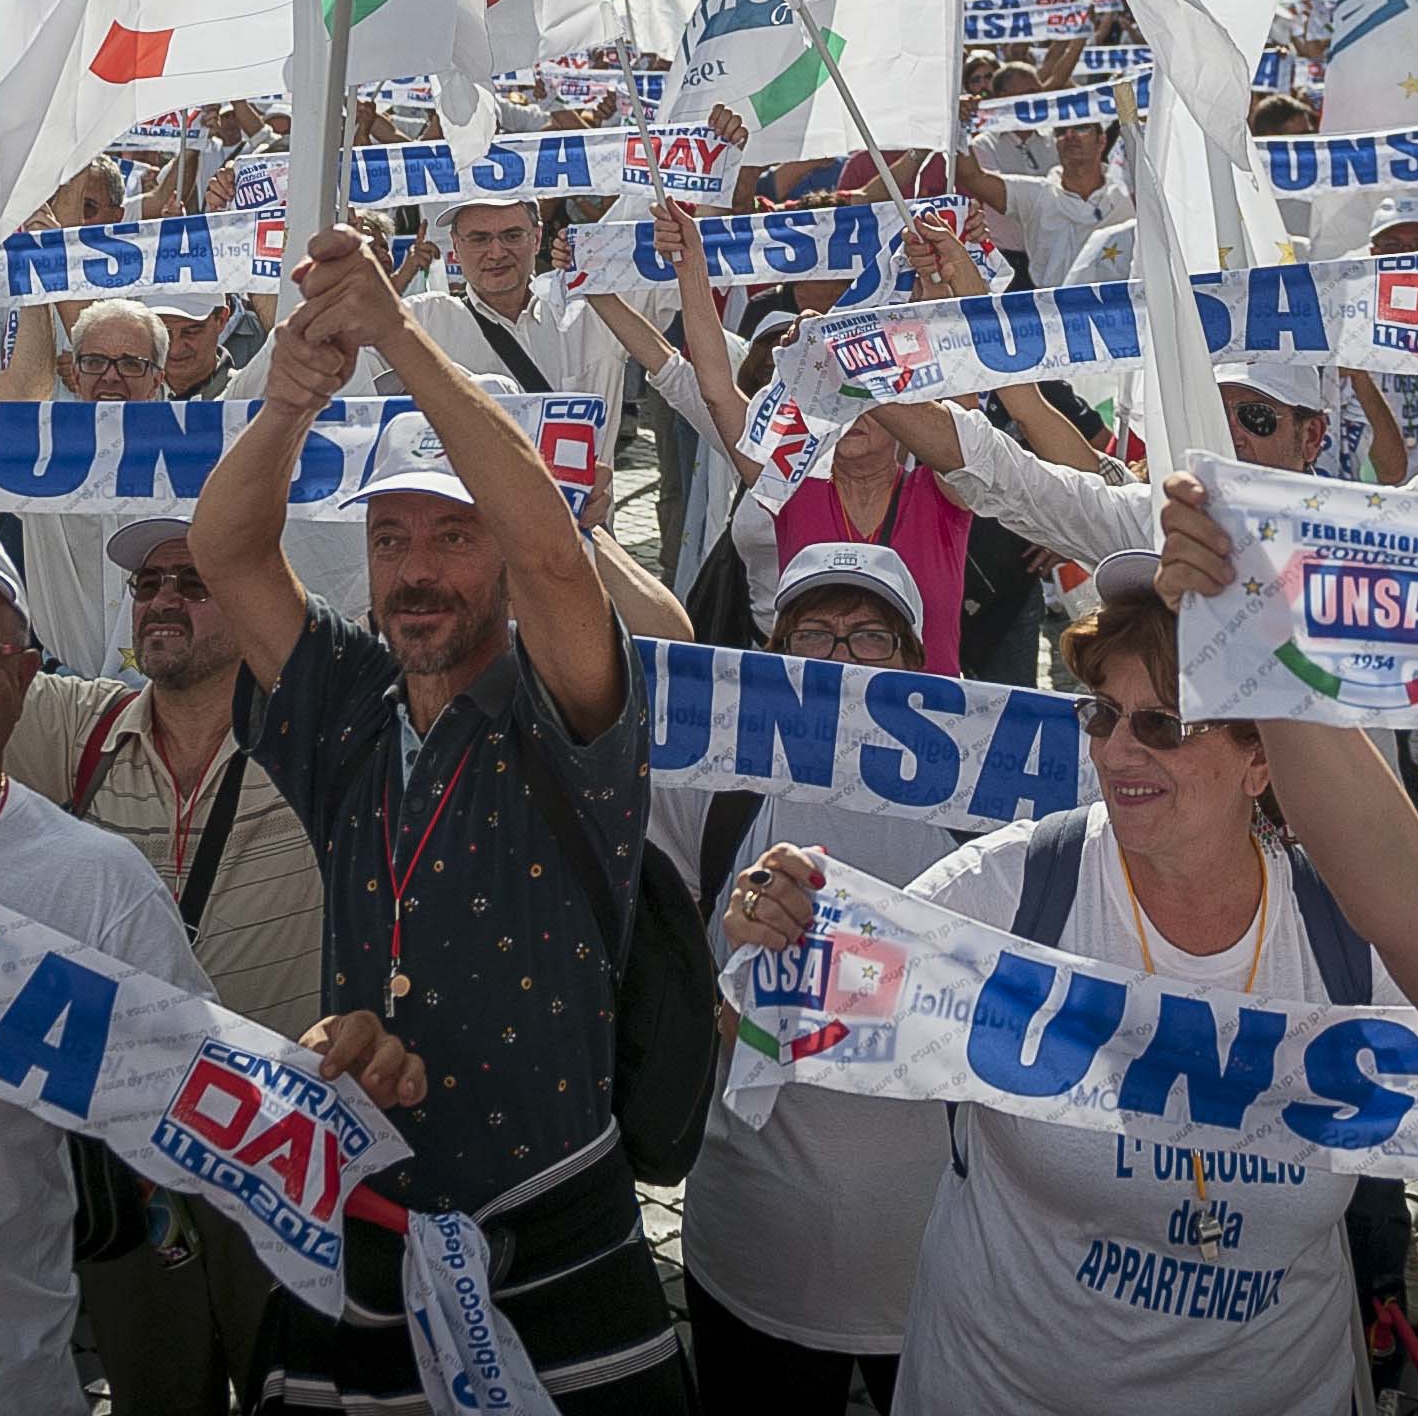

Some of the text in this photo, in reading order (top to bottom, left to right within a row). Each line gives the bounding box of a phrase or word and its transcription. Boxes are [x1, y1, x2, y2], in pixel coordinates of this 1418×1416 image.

[965, 12, 1090, 40] NSA DAY
[1084, 49, 1153, 71] UNS
[141, 109, 202, 128] AY
[349, 137, 593, 203] UNSA
[626, 136, 728, 174] DAY
[236, 181, 275, 208] UNSA
[633, 206, 881, 282] UNSA
[837, 335, 891, 374] UNSA
[1350, 653, 1396, 672] 1954
[633, 636, 1080, 822] UNSA
[172, 1059, 349, 1221] DAY
[156, 1123, 343, 1270] 11.10.2014
[1076, 1240, 1285, 1323] APPARTENENZ
[456, 1276, 501, 1380] sblocco
[487, 1386, 512, 1410] lo
